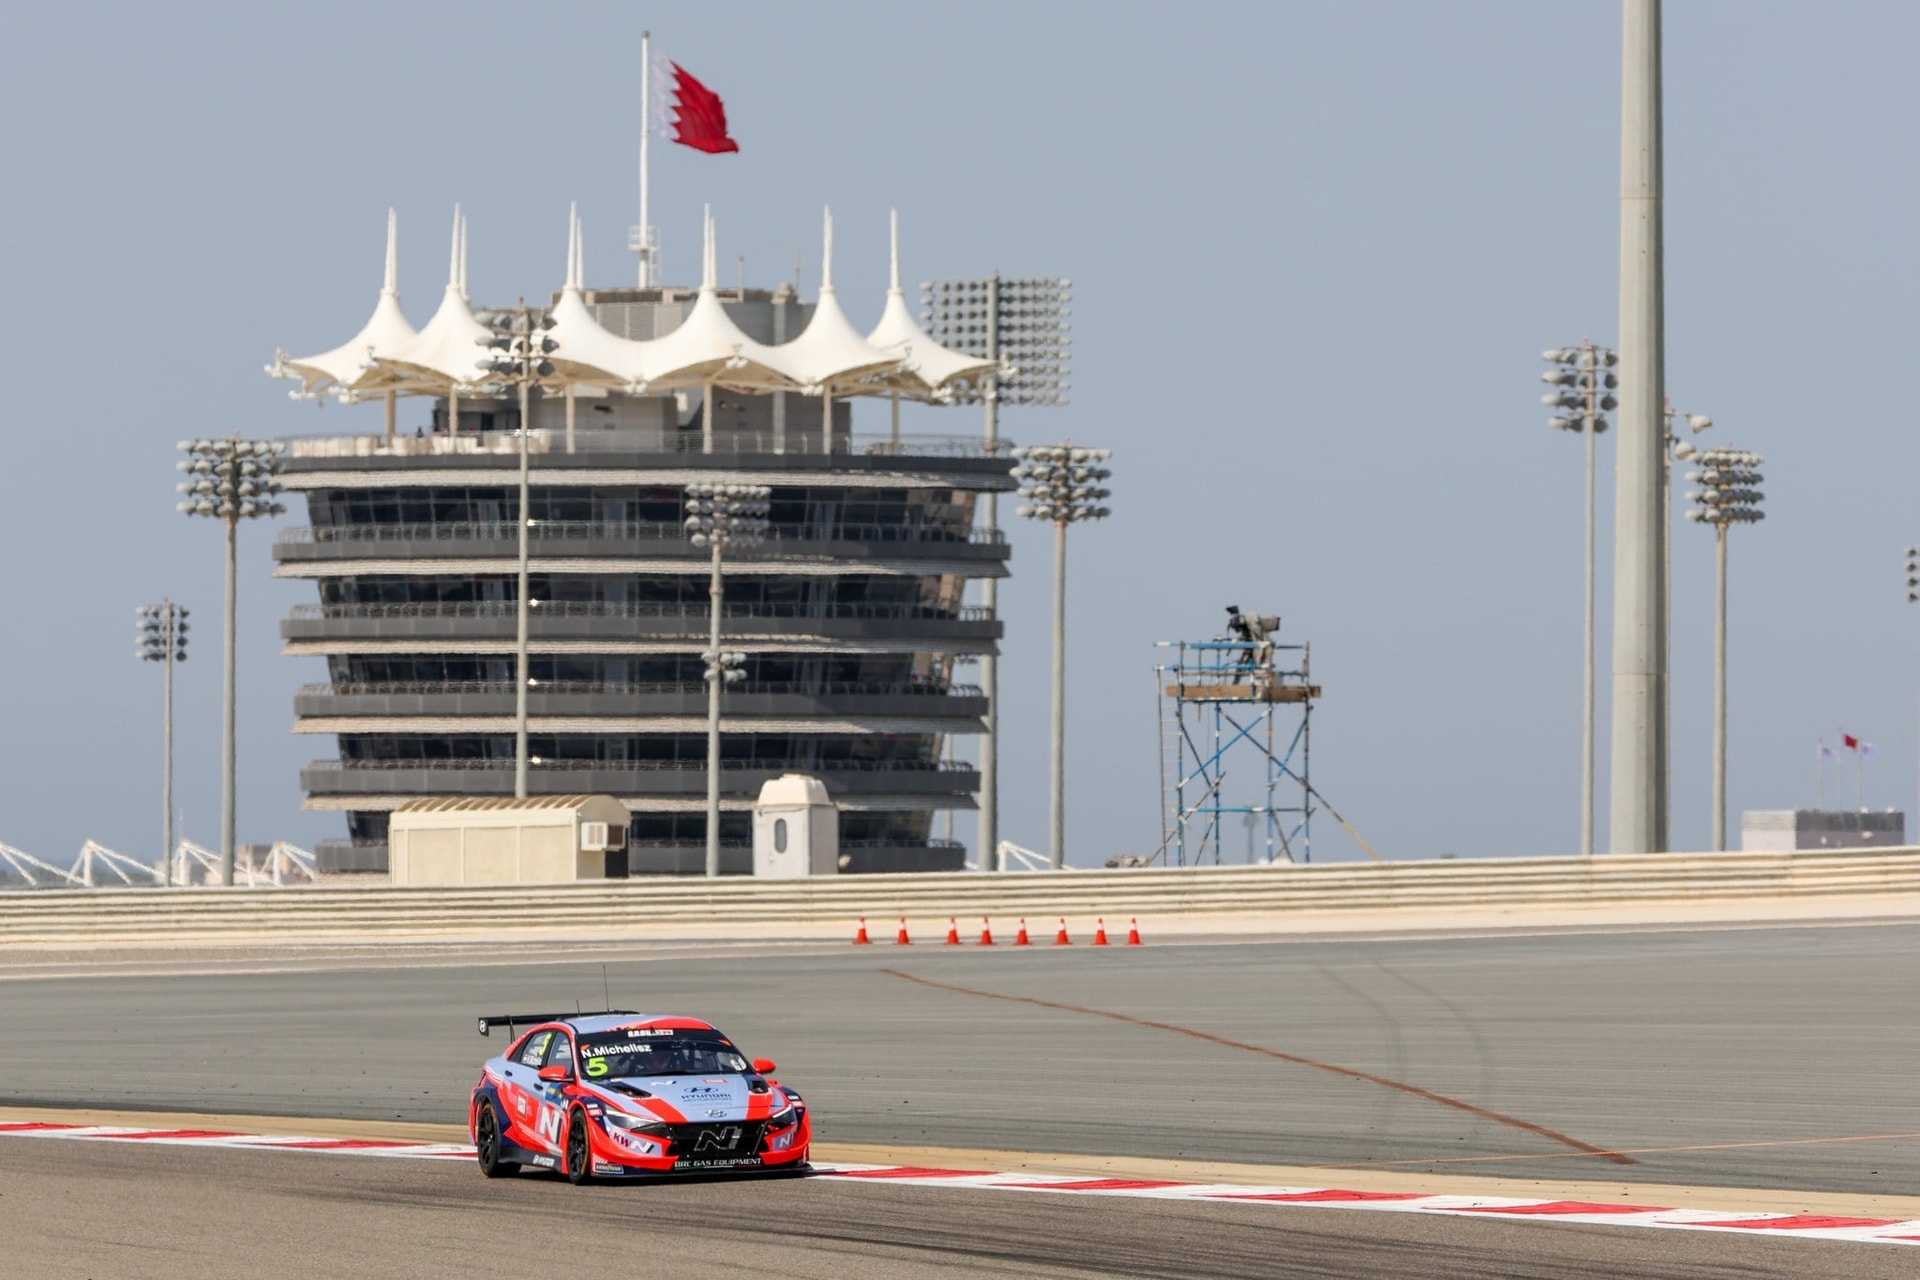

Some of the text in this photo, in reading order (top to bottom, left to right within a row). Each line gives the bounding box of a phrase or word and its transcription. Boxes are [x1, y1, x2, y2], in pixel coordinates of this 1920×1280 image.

[581, 1043, 653, 1059] N.Michelisz
[587, 1057, 608, 1077] 5
[540, 1105, 563, 1145] N
[675, 1160, 692, 1168] BRC
[713, 1157, 762, 1166] EQUIPMENT
